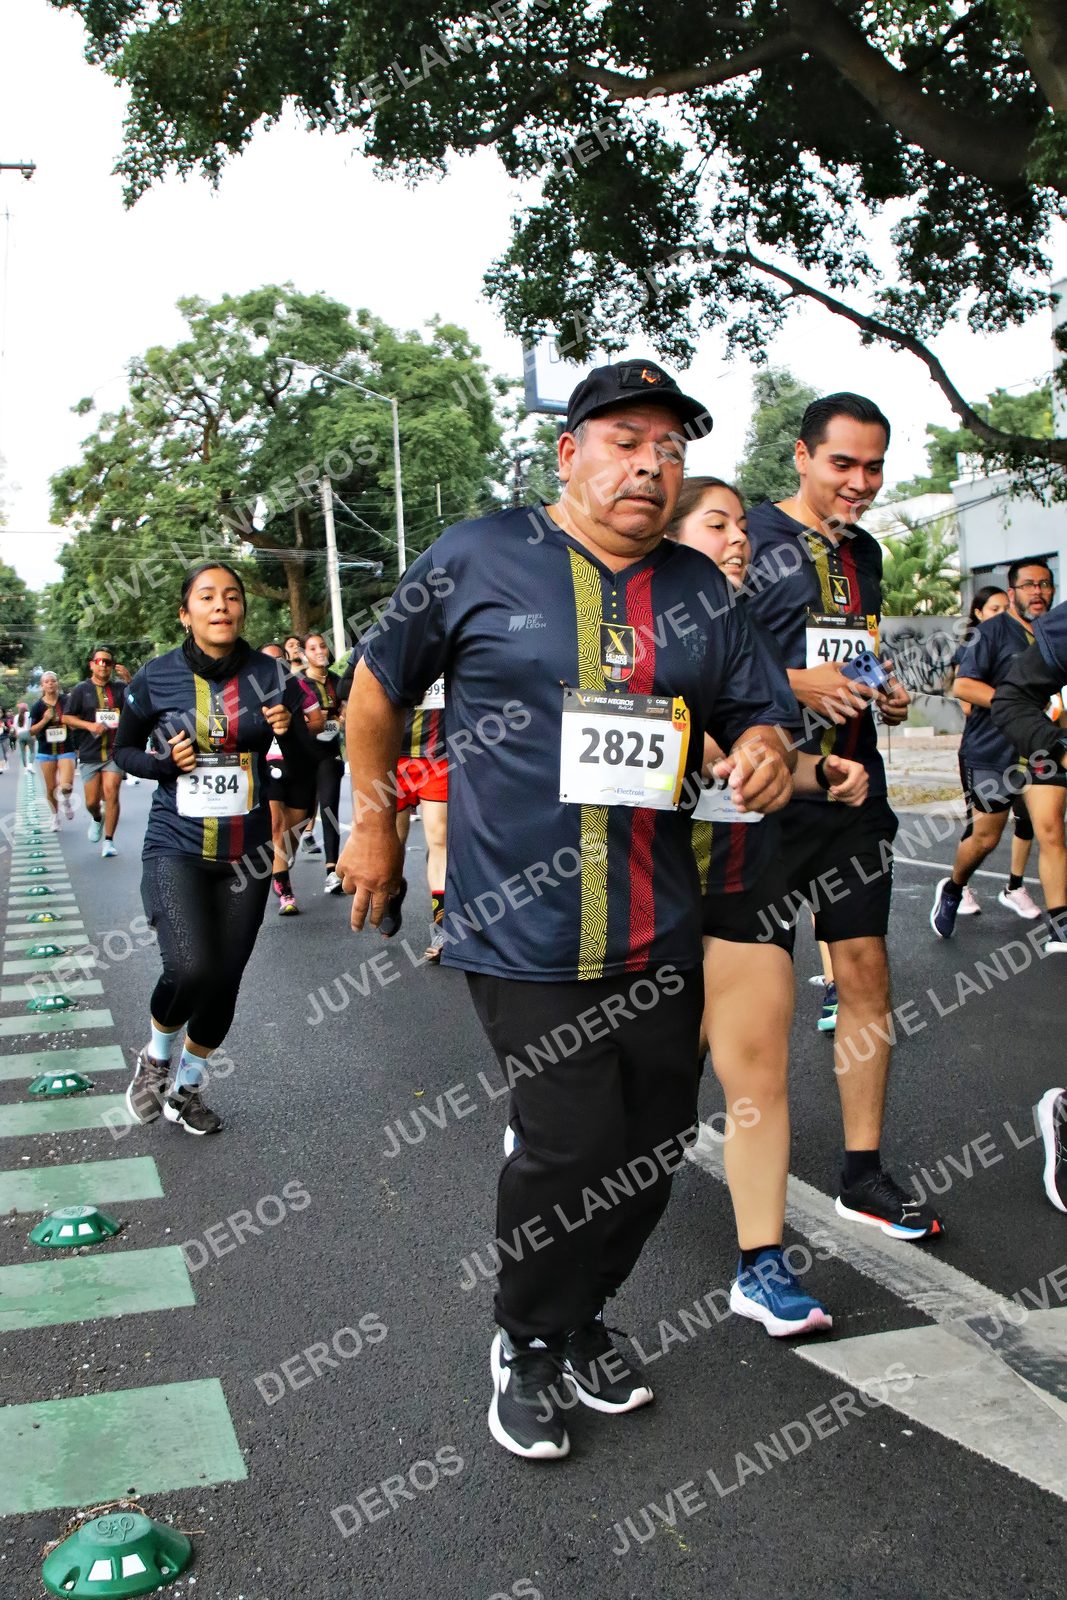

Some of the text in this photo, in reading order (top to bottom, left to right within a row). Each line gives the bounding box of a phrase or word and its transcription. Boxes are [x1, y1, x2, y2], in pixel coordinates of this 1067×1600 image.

[818, 638, 866, 662] 4729
[579, 727, 665, 769] 2825
[189, 774, 239, 794] 3584
